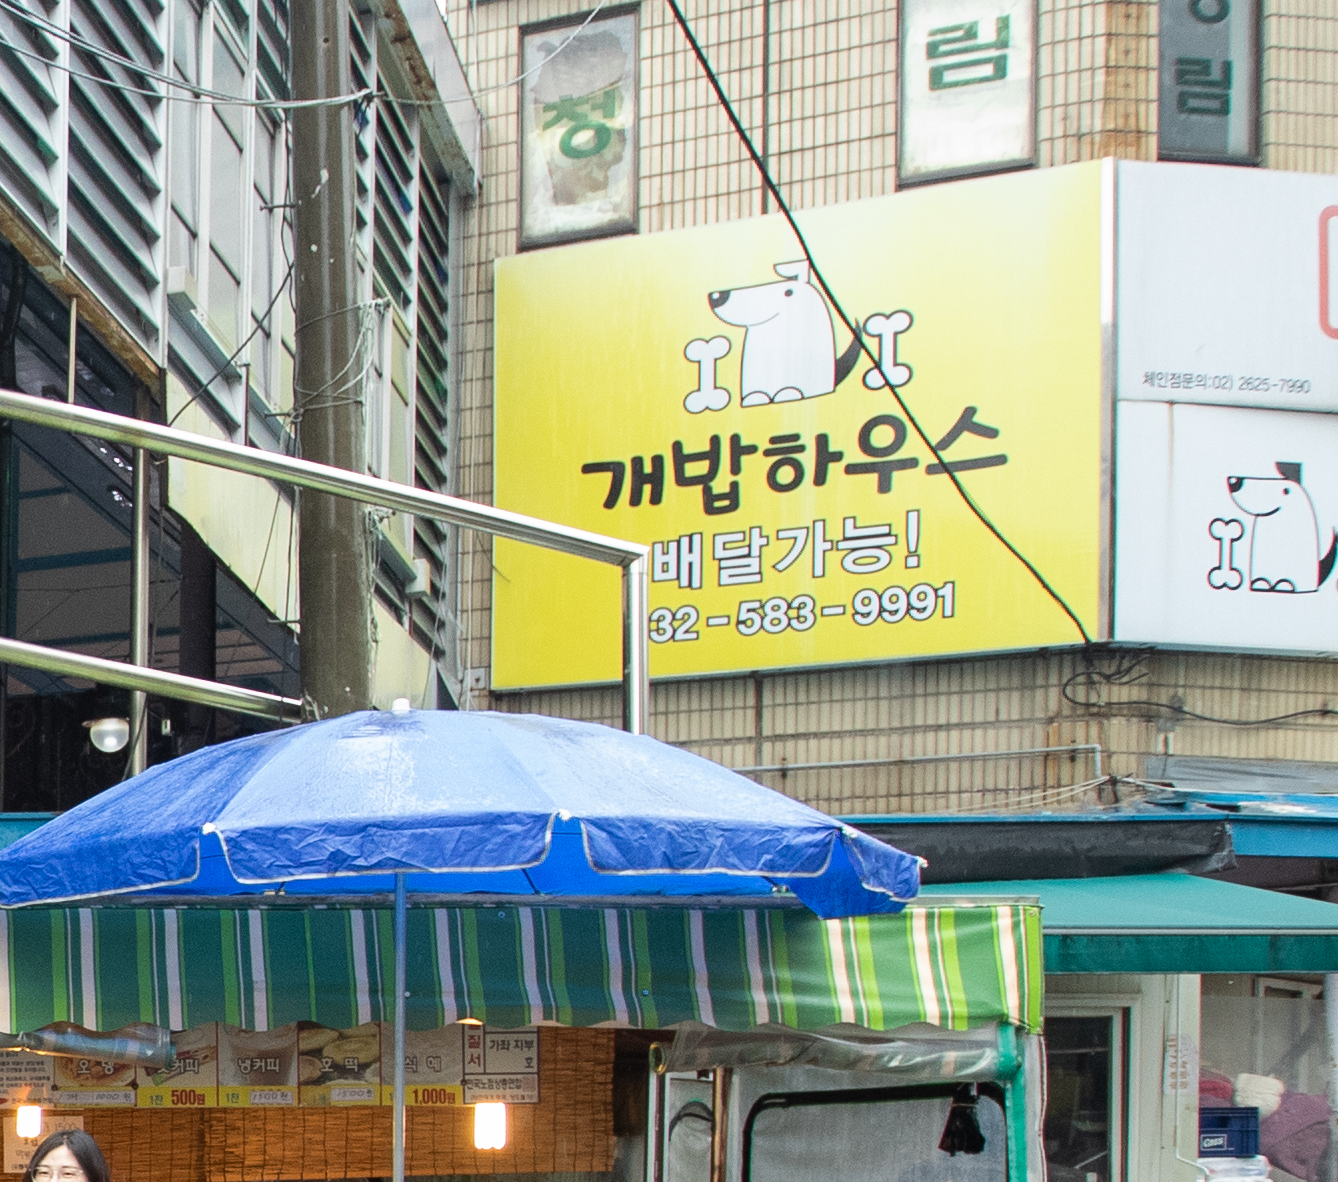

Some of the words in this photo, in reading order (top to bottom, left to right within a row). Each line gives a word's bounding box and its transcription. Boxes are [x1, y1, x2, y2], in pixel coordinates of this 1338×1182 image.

[925, 14, 1011, 91] 림
[580, 406, 1008, 516] 개밥하우스
[650, 510, 923, 591] 배달가능!
[649, 582, 957, 645] 32-583-9991
[170, 1089, 206, 1106] 500원
[238, 1058, 281, 1074] 냉커피
[412, 1087, 456, 1105] 1,000원
